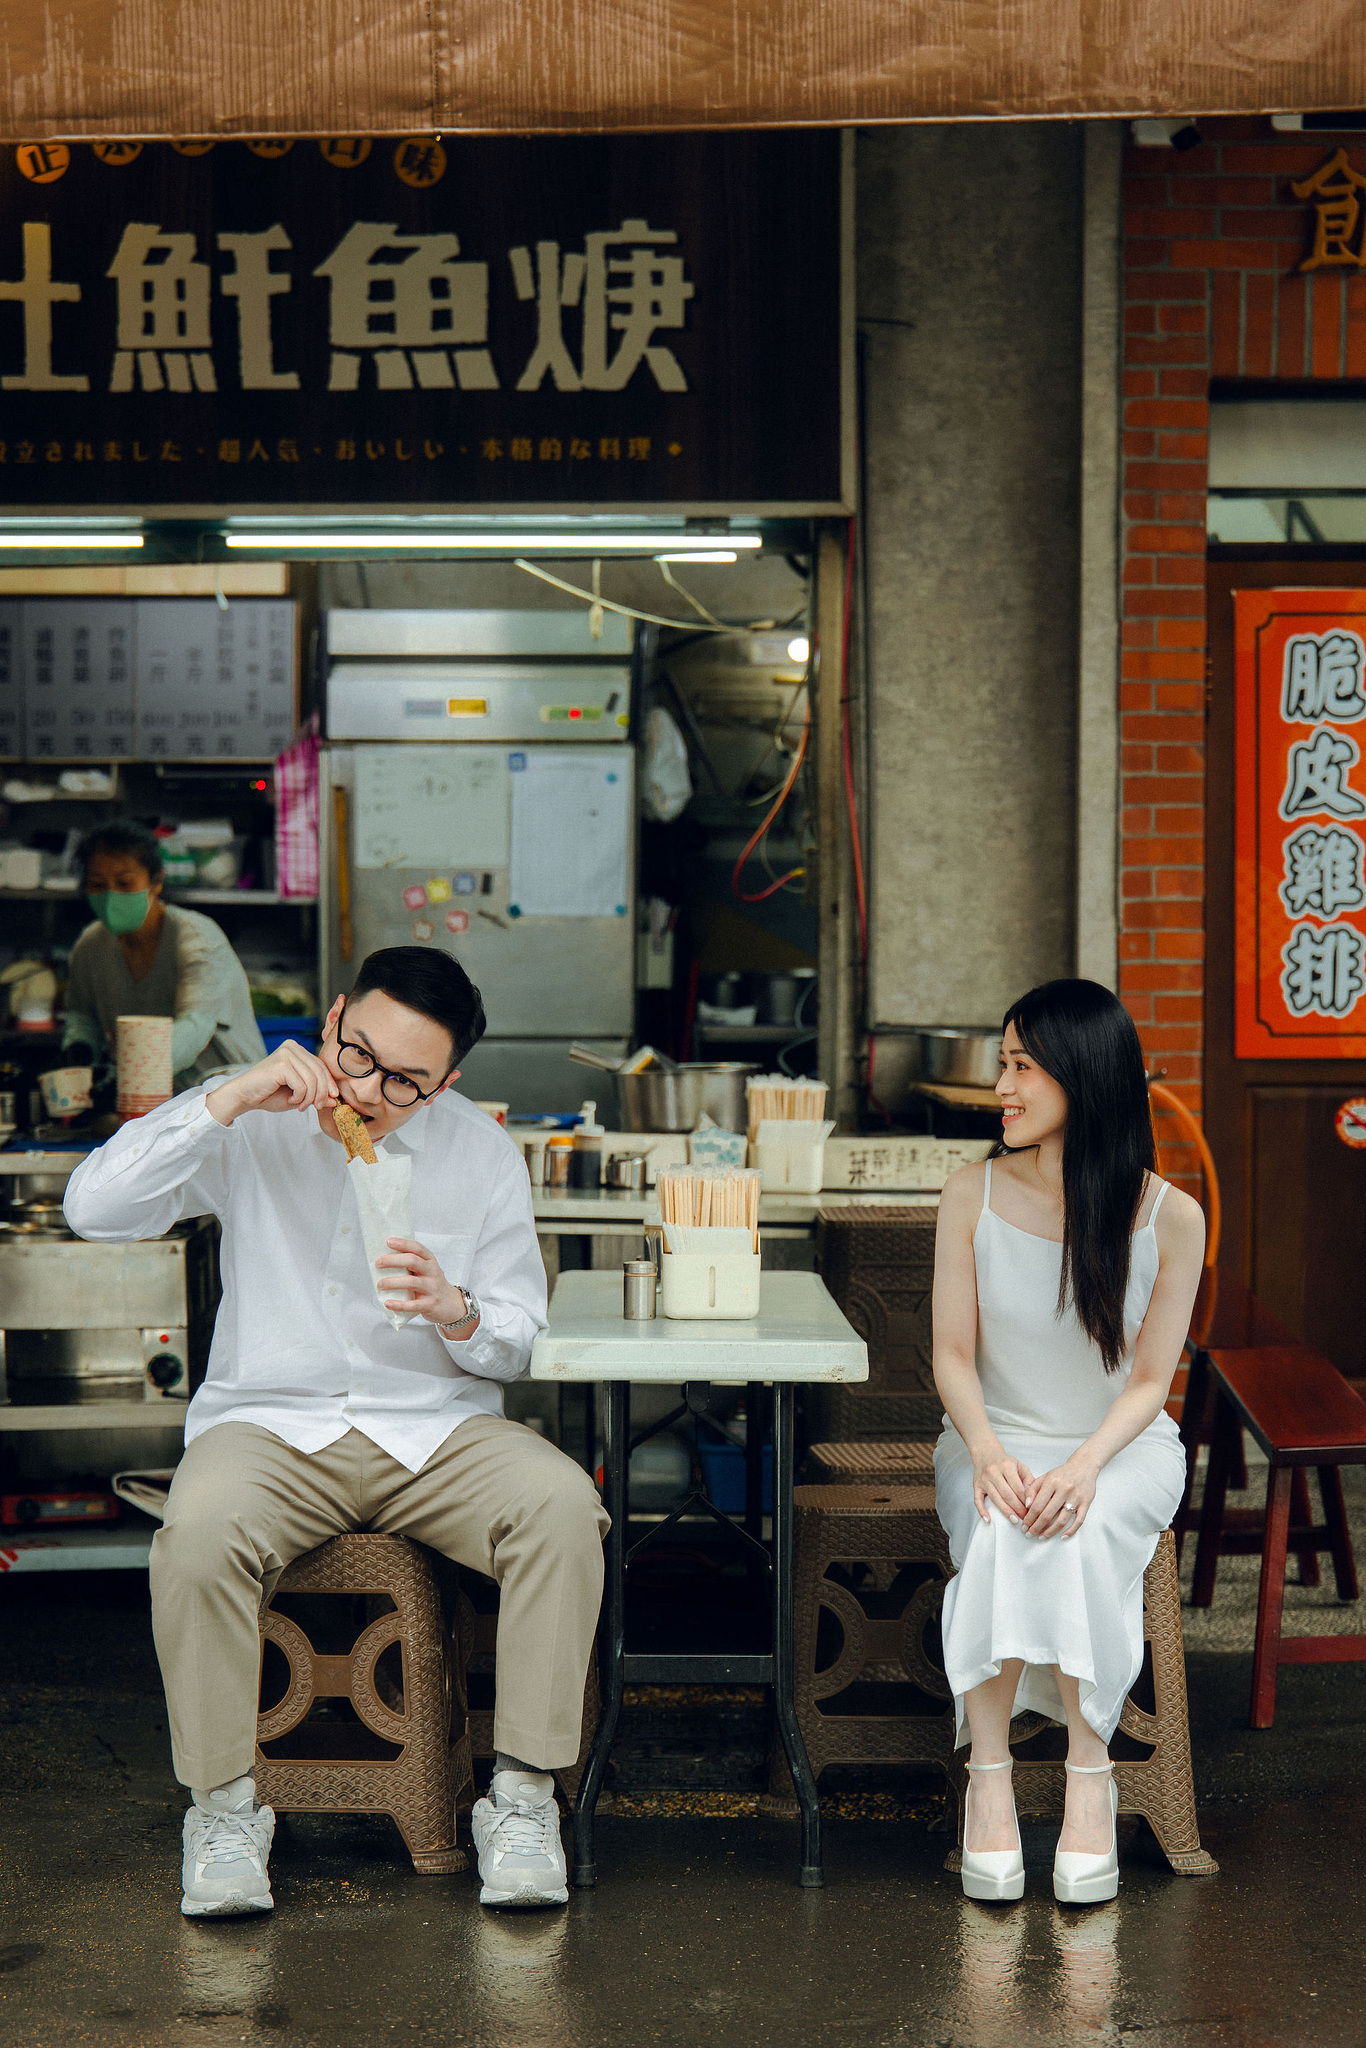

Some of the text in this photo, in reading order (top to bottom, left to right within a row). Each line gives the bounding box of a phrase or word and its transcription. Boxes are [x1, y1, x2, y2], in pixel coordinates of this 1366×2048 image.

[24, 139, 438, 182] 正口味
[1281, 630, 1366, 1020] 脆皮雞排
